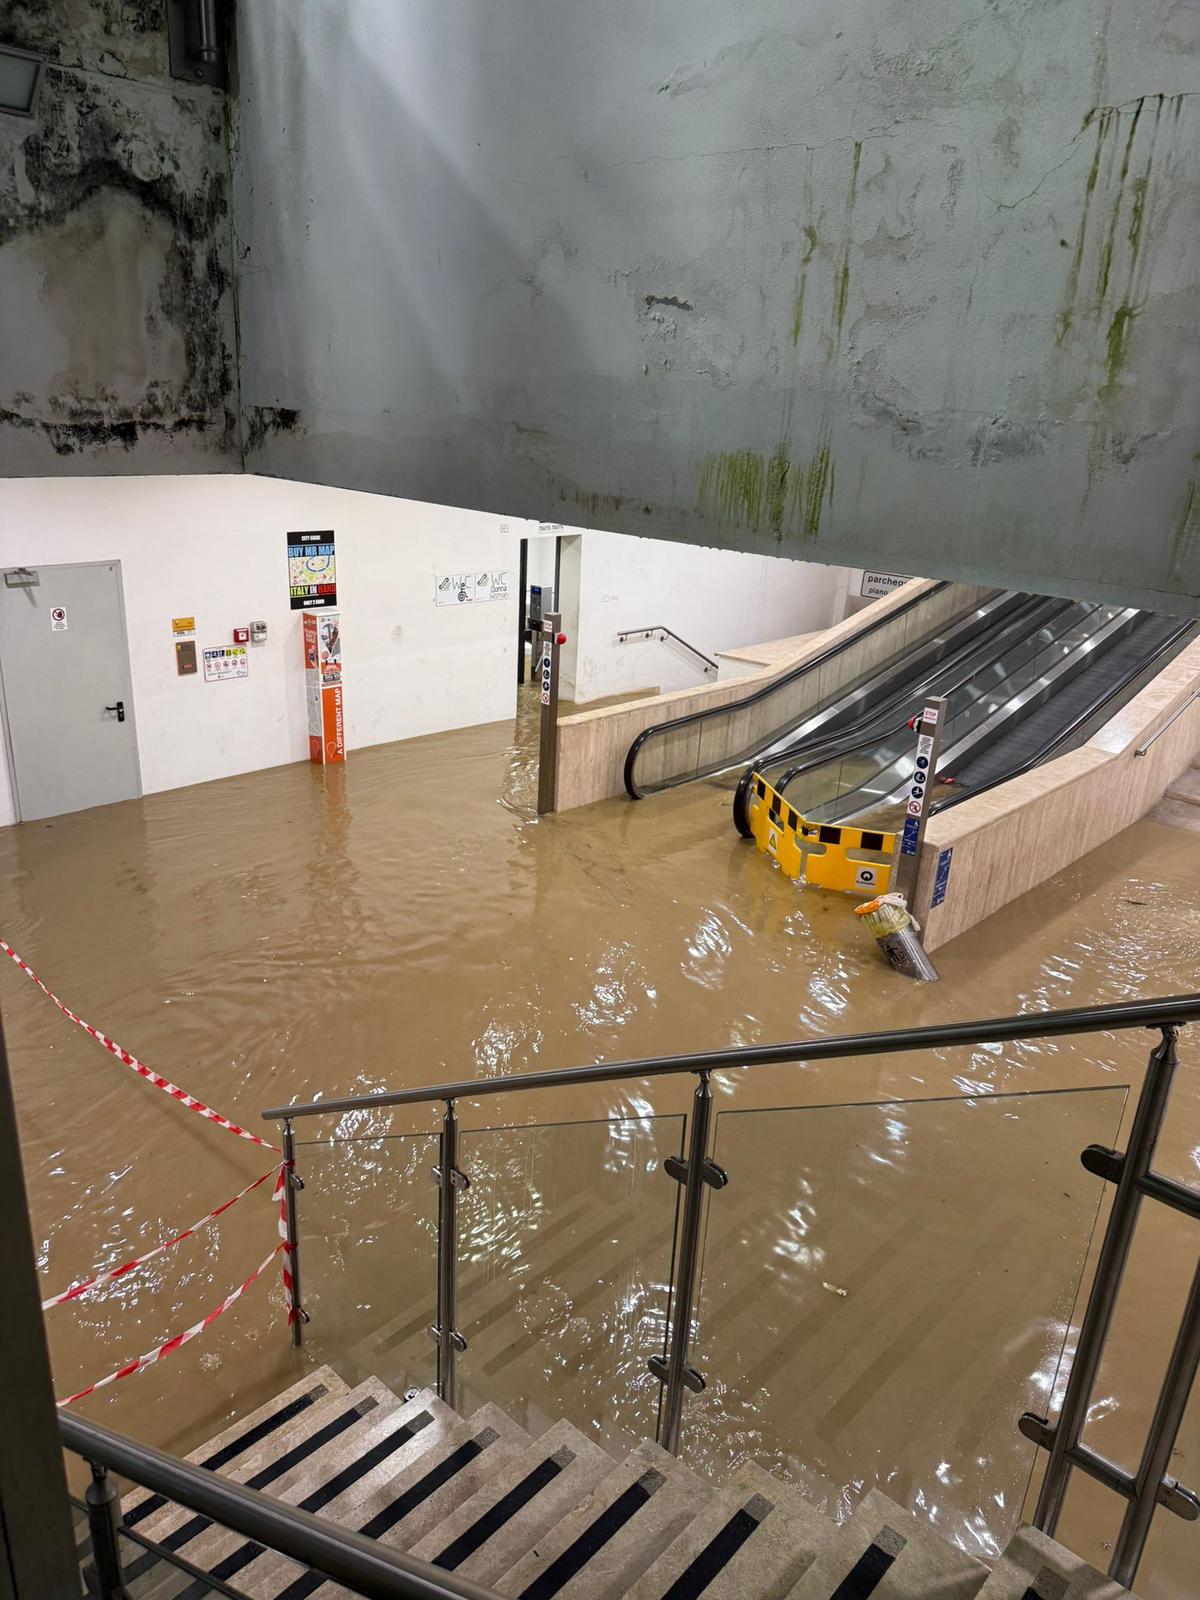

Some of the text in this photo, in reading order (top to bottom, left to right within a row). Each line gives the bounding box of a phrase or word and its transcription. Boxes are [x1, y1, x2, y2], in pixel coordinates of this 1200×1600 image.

[288, 547, 303, 557] BUY
[319, 546, 334, 556] MAP
[452, 575, 471, 590] WC
[491, 572, 507, 586] WC
[868, 576, 908, 587] parcheg
[290, 586, 308, 597] ITALY
[310, 585, 317, 594] IN
[490, 585, 508, 593] Donna
[334, 688, 342, 705] MAP
[335, 706, 343, 748] DIFFERENT
